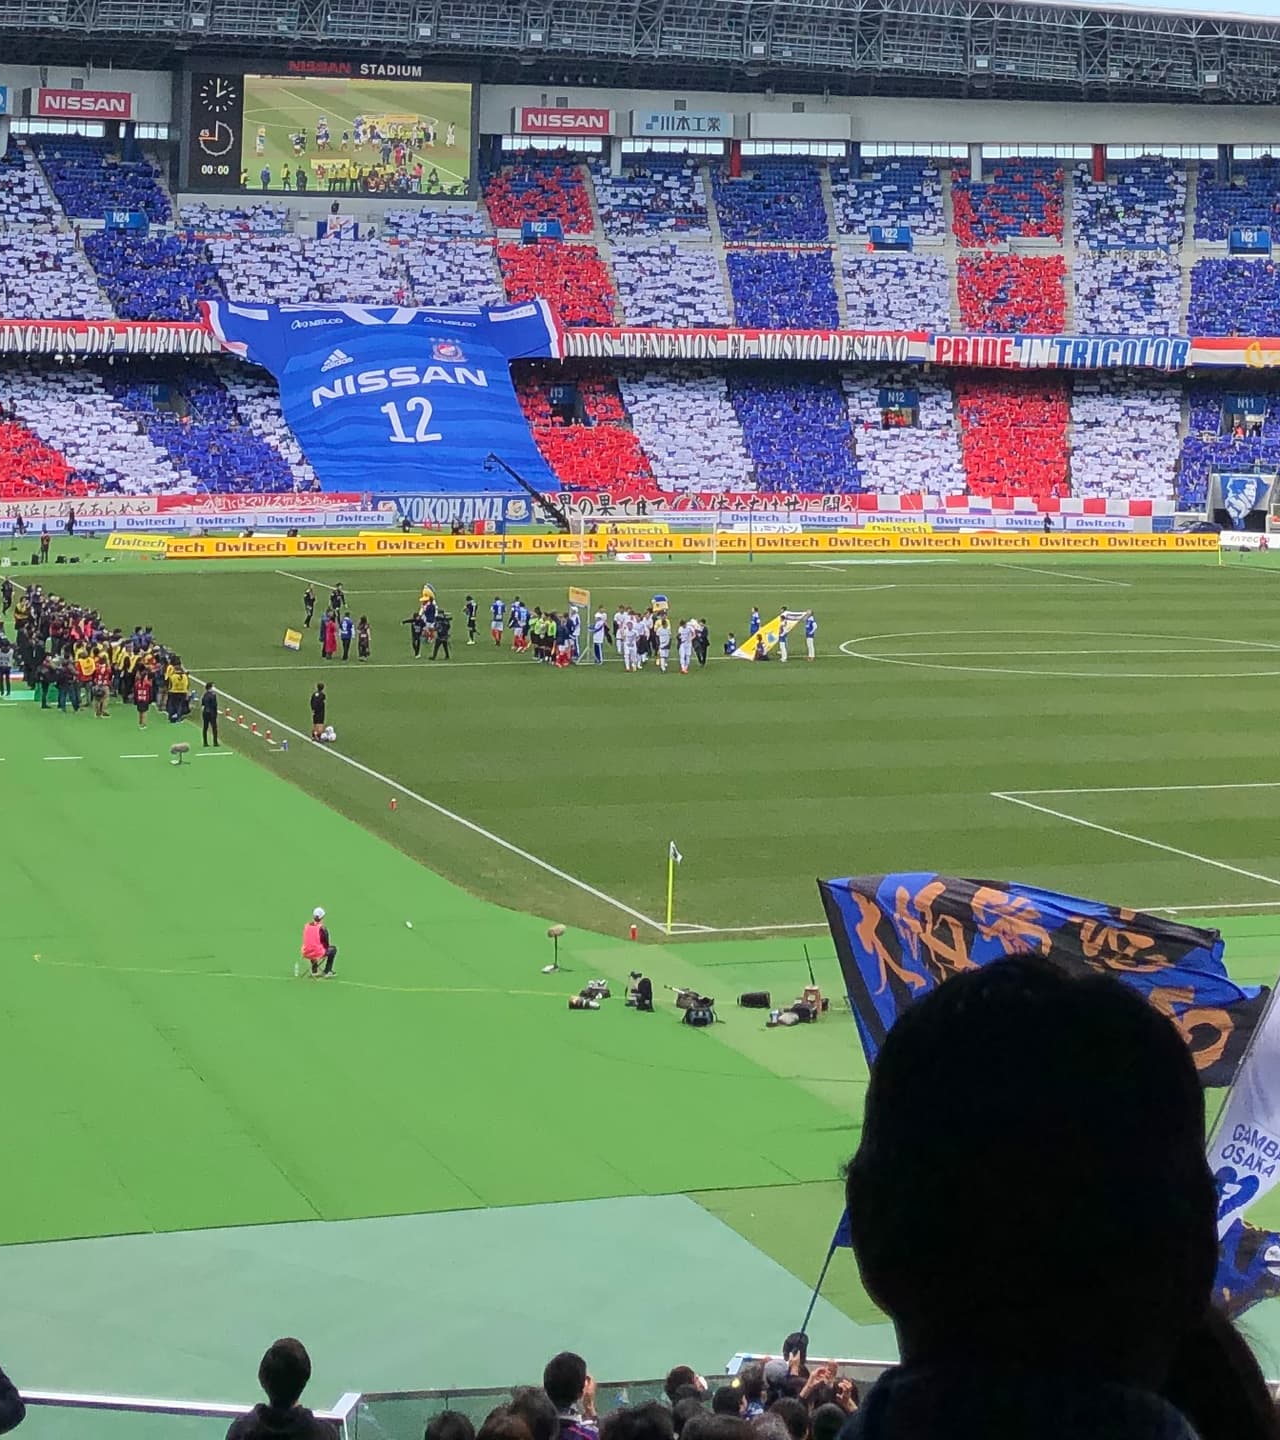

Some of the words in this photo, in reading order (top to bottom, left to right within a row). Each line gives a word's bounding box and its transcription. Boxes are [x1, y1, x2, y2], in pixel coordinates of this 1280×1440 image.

[360, 64, 422, 77] STADIUM
[45, 95, 125, 112] NISSAN
[527, 113, 604, 128] NISSAN
[201, 164, 229, 175] 00:00
[112, 212, 130, 224] N24
[881, 227, 898, 239] N22
[85, 326, 117, 354] DE
[126, 327, 213, 354] MARINOS
[562, 332, 615, 358] ODOS
[620, 333, 719, 359] TENEMOS
[726, 334, 751, 360] EL
[758, 334, 822, 360] MISMO
[827, 334, 909, 361] DESTINO
[934, 336, 1015, 366] PRIDE
[1020, 337, 1055, 368] IN
[1054, 336, 1191, 371] TRICOLOR
[311, 366, 489, 408] NISSAN
[887, 391, 905, 403] N12
[1237, 398, 1255, 409] N11
[380, 396, 442, 443] 12
[399, 495, 504, 522] YOKOHAMA
[126, 516, 176, 527] Owltech
[196, 515, 246, 525] Owltech
[267, 514, 316, 524] Owltech
[336, 512, 385, 523] Owltech
[731, 513, 780, 523] Owltech
[800, 513, 848, 523] Owltech
[867, 515, 916, 524] Owltech
[936, 516, 986, 527] Owltech
[1076, 518, 1126, 529] Owltech
[112, 536, 166, 549] Owltech
[215, 540, 279, 553] Owltech
[297, 539, 367, 552] Owltech
[377, 538, 445, 551] Owltech
[455, 538, 523, 550] Owltech
[532, 538, 599, 549] Owltech
[756, 536, 820, 548] Owltech
[828, 536, 891, 548] Owltech
[899, 536, 962, 548] Owltech
[970, 536, 1031, 548] Owltech
[1039, 536, 1099, 548] Owltech
[1108, 536, 1167, 548] Owltech
[1221, 1143, 1276, 1178] OSAKA
